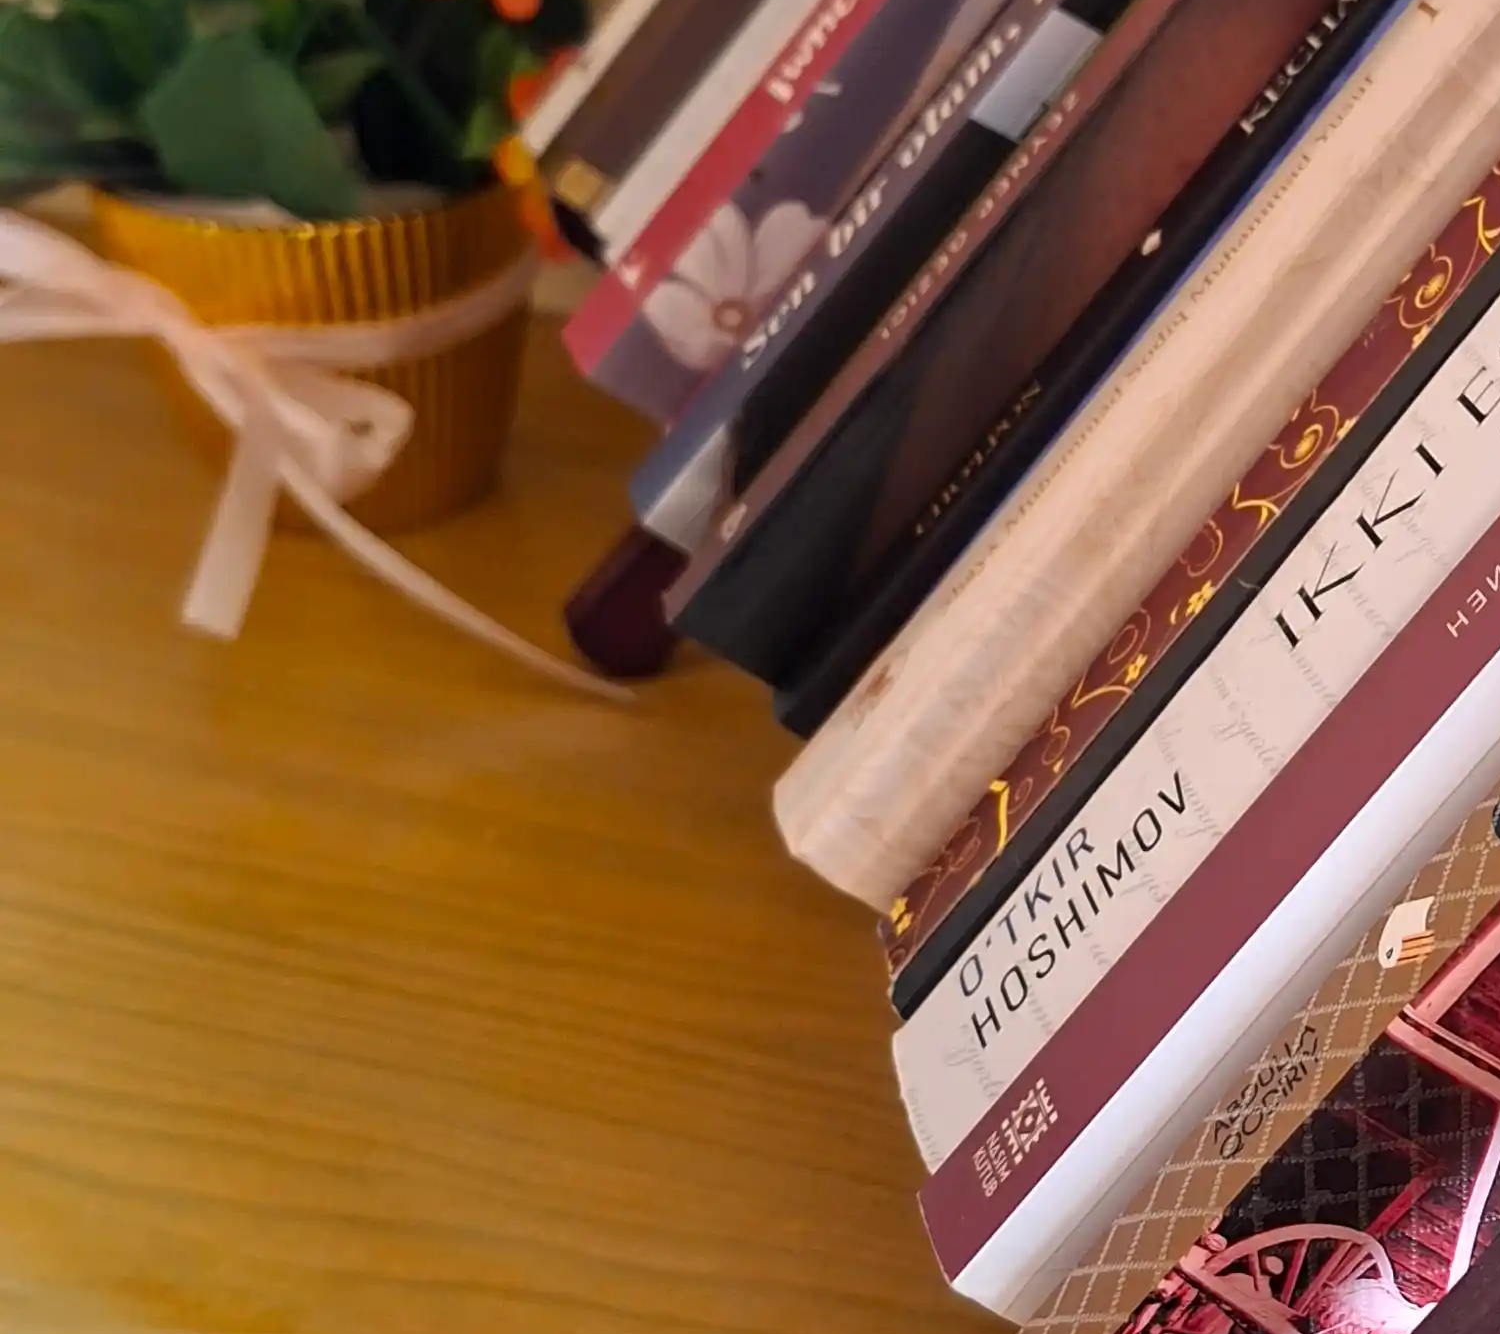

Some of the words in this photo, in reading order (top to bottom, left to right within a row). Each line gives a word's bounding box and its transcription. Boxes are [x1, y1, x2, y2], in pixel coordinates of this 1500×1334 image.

[738, 269, 818, 371] Sen
[822, 175, 891, 259] bir
[1270, 441, 1449, 650] IKKI
[965, 769, 1185, 1048] HOSHIMOV
[1212, 1029, 1316, 1143] ABDULLA
[1219, 1036, 1319, 1160] QODIRIY
[971, 1145, 1000, 1197] KUTUB
[986, 1130, 1013, 1182] NASIM
